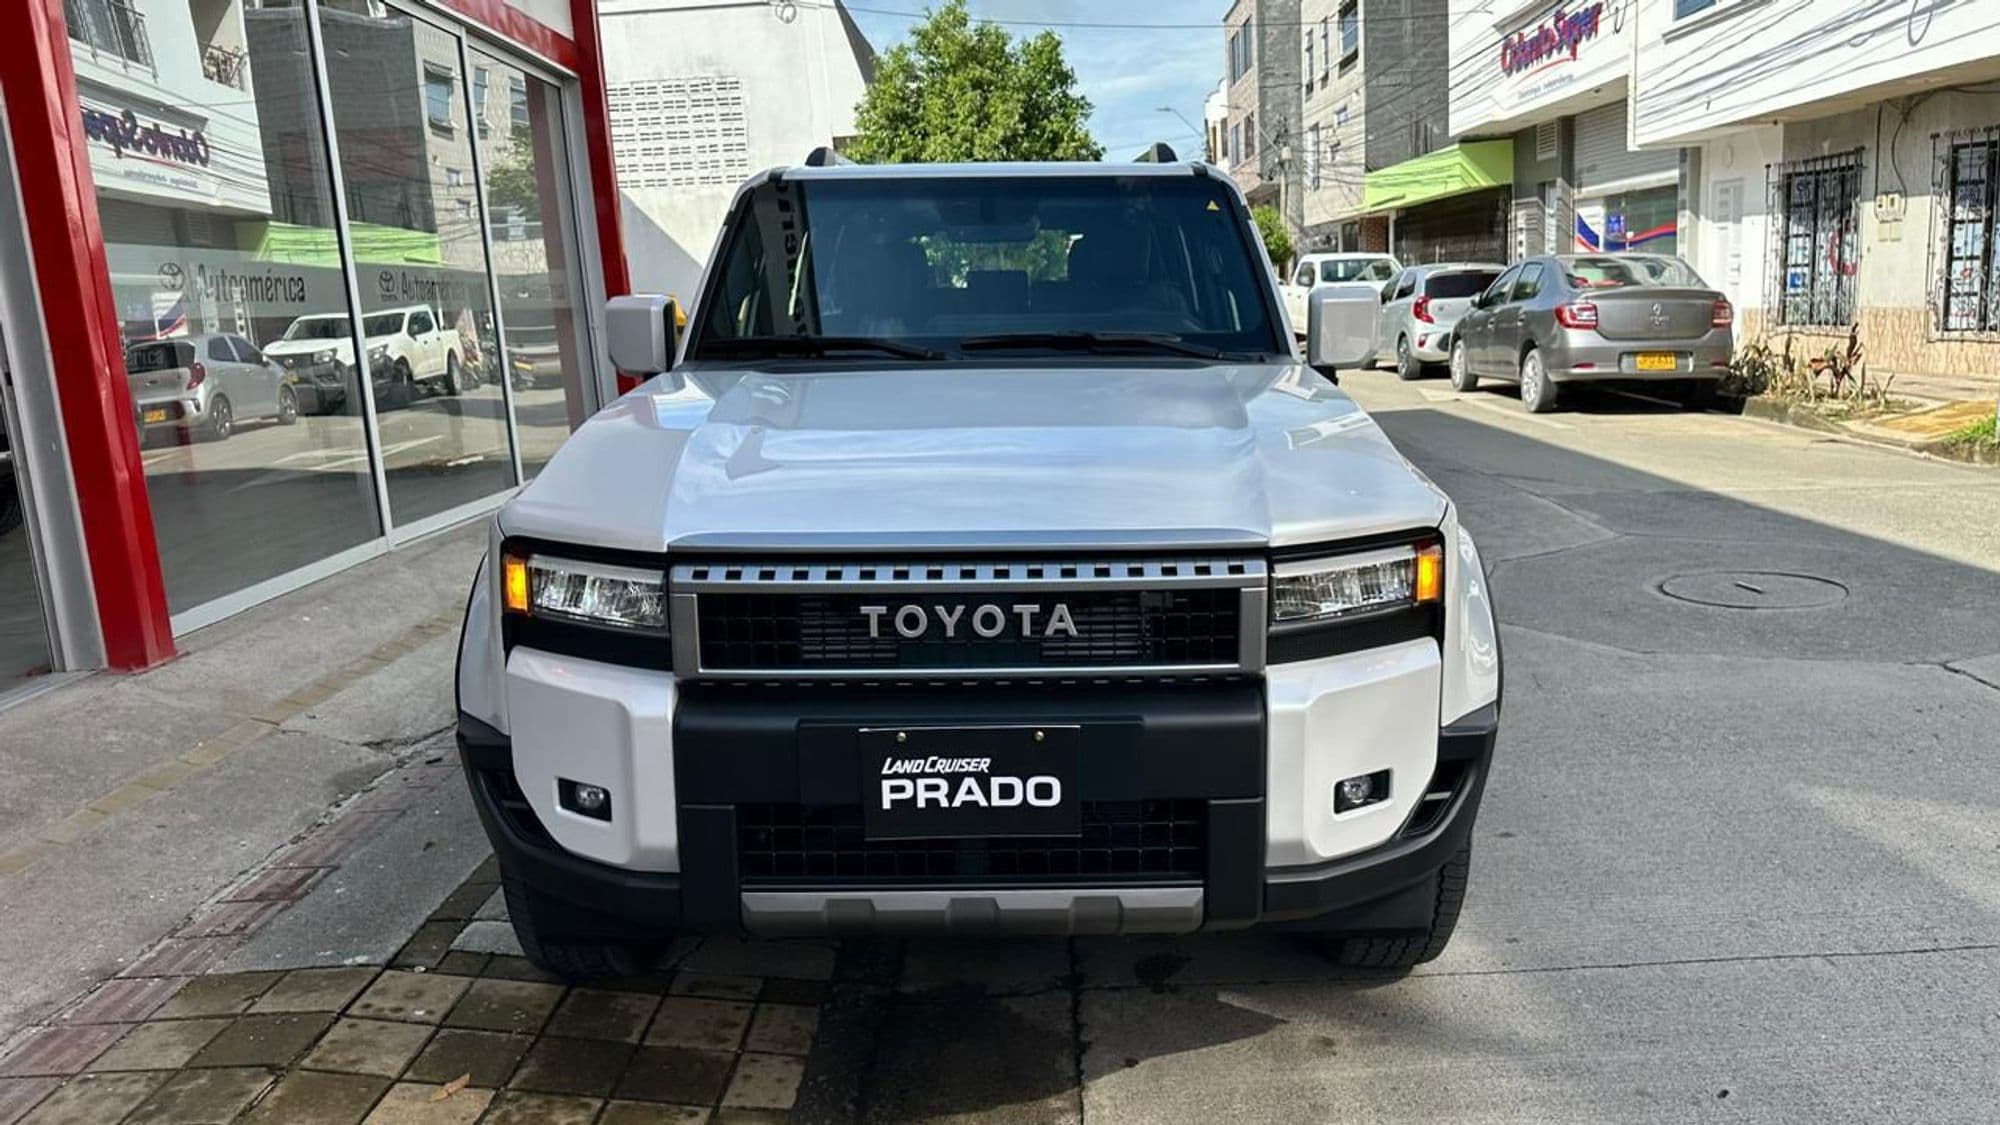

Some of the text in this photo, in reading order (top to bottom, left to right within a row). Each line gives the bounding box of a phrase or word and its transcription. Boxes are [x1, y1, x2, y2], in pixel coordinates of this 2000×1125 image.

[198, 263, 305, 302] Autoamérica
[860, 604, 1078, 638] TOYOTA
[881, 756, 992, 775] LAND CRUISER
[881, 776, 1062, 810] PRADO
